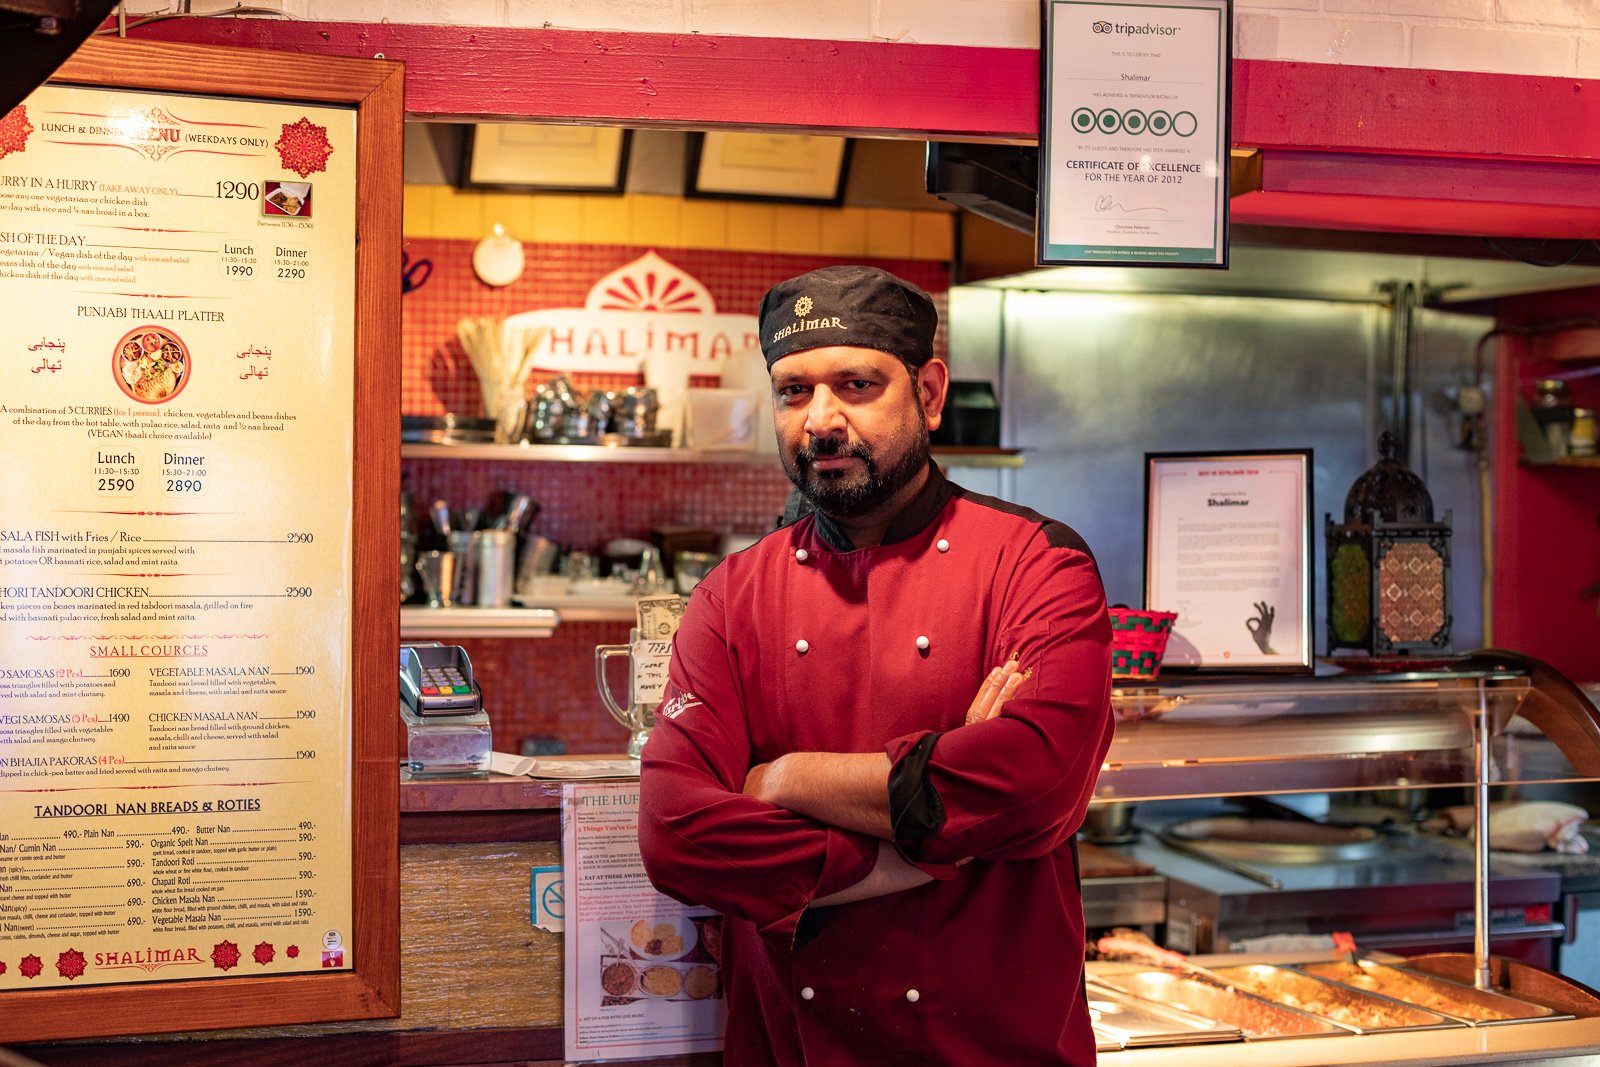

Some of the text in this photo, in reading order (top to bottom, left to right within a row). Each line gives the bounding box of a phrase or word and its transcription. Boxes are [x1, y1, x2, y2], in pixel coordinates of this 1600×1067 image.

[1115, 22, 1177, 36] tripadvisor
[1120, 73, 1150, 82] Shalimar
[41, 123, 75, 133] LUNCH
[78, 126, 86, 134] &
[185, 134, 237, 145] (WEEKDAYS
[239, 137, 269, 147] ONLY)
[1066, 160, 1200, 173] CERTIFICATE OF XCELLENCE
[31, 177, 42, 188] IN
[45, 178, 54, 189] A
[56, 178, 97, 191] HURRY
[1085, 173, 1182, 184] FOR THE YEAR OF 2012
[216, 181, 259, 200] 1290
[224, 244, 254, 255] Lunch
[276, 246, 308, 258] Dinner
[226, 265, 253, 276] 1990
[278, 268, 306, 279] 2290
[78, 306, 225, 322] PUNJABI THAALI PLATTER
[8, 405, 57, 414] combination
[74, 406, 113, 416] CURRIES
[98, 451, 135, 464] Lunch
[164, 452, 205, 466] Dinner
[98, 478, 134, 491] 2590
[166, 479, 202, 492] 2890
[1207, 498, 1249, 507] Shalimar
[35, 530, 59, 542] FISH
[61, 531, 84, 542] with
[86, 531, 109, 542] Fries
[120, 532, 142, 542] Rice
[285, 532, 314, 544] 2590
[3, 545, 30, 554] masala
[32, 545, 46, 554] fish
[47, 545, 87, 554] marinated
[98, 545, 127, 556] punjabi
[152, 546, 177, 554] served
[178, 546, 195, 554] with
[32, 587, 94, 598] TANDOORI
[96, 587, 149, 598] CHICKEN
[284, 586, 312, 598] 2590
[90, 645, 208, 657] SMALL COURCES
[4, 669, 55, 678] SAMOSAS
[107, 668, 131, 678] 1690
[149, 666, 270, 677] VEGETABLE MASALA NAN
[294, 666, 315, 675] 1590
[22, 714, 71, 724] SAMOSAS
[107, 713, 130, 722] 1490
[148, 711, 258, 722] CHICKEN MASALA NAN
[294, 710, 316, 719] 1590
[294, 750, 316, 760] 1590
[10, 757, 48, 767] BHAJIA
[50, 756, 98, 766] PAKORAS
[582, 796, 610, 806] THE
[34, 798, 260, 817] TANDOORI NAN BREADS & ROTIES
[84, 829, 115, 838] Plain Nan
[196, 824, 230, 834] Butter Nan
[18, 843, 41, 853] Cumin
[42, 843, 57, 852] Nan
[150, 838, 176, 849] Organic
[195, 838, 208, 846] Nan
[151, 858, 180, 867] Tandoori
[152, 894, 216, 906] Chicken Masala Nan
[152, 913, 222, 926] Vegetable Masala Nan
